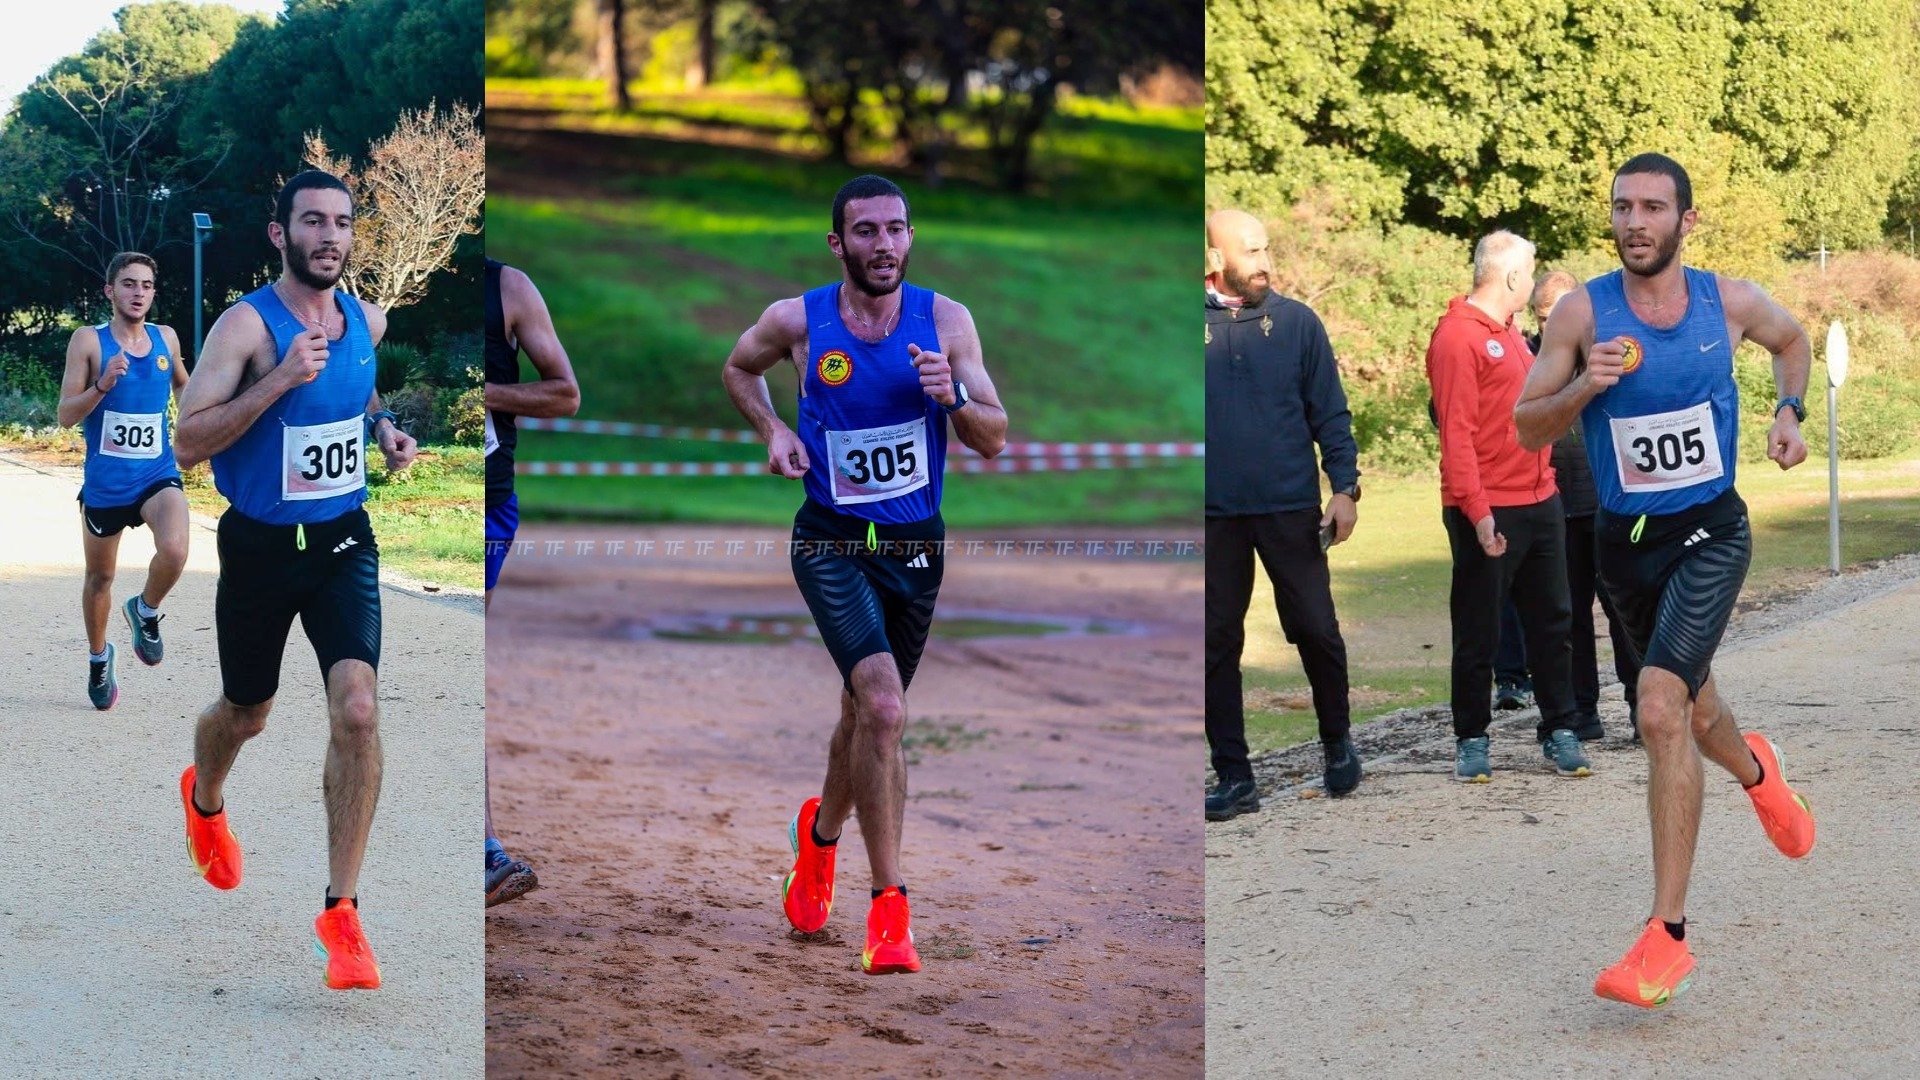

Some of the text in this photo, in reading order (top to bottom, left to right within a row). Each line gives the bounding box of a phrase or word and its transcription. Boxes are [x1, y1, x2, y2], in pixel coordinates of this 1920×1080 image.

[112, 425, 155, 448] 303
[1632, 427, 1705, 473] 305
[301, 437, 358, 481] 305
[846, 440, 916, 485] 305
